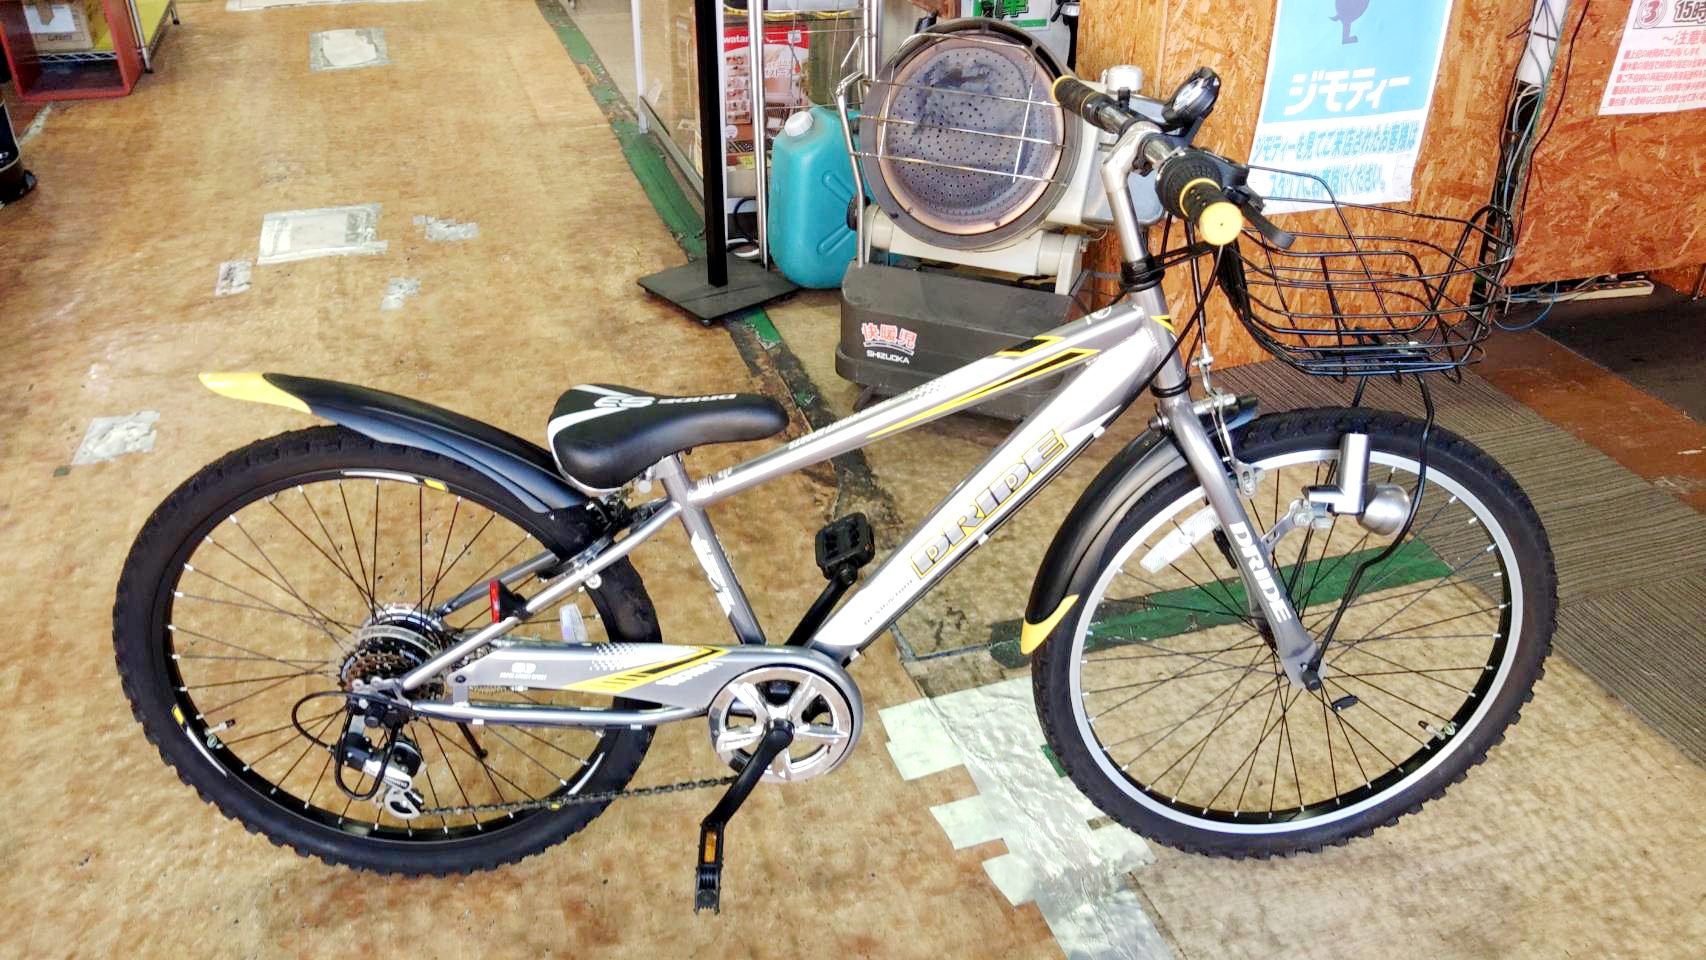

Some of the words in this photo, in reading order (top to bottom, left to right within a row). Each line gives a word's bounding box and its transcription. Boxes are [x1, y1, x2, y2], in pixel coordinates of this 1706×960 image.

[1283, 67, 1412, 116] ジモティー
[866, 350, 910, 364] SHIZUOKA
